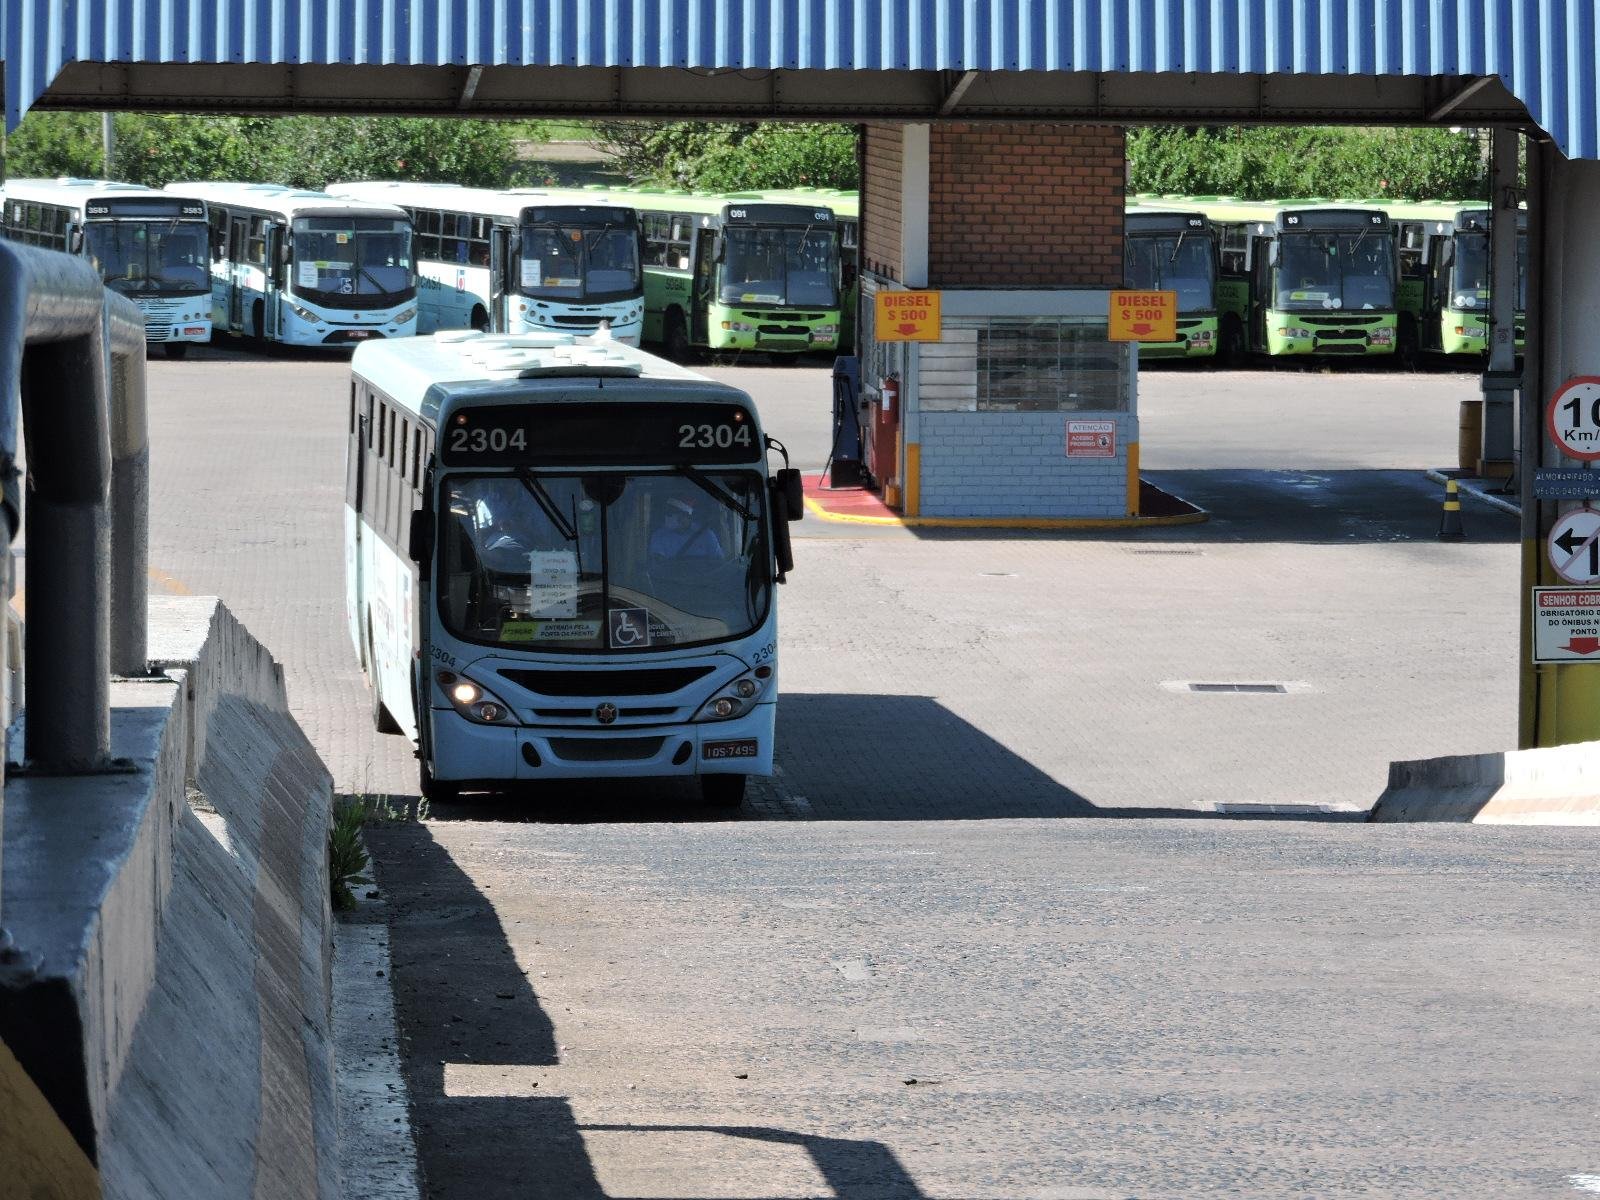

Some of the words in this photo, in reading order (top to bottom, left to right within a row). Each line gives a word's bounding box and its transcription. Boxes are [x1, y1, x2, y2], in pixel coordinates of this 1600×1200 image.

[730, 209, 747, 218] 091
[814, 212, 829, 221] 091
[884, 295, 932, 307] DIESEL
[1118, 295, 1167, 307] DIESEL
[901, 310, 927, 321] 500
[1135, 310, 1163, 321] 500
[450, 428, 528, 452] 2304
[678, 424, 751, 449] 2304
[1542, 595, 1577, 605] SENHOR
[1562, 617, 1591, 626] ÔNIBUS
